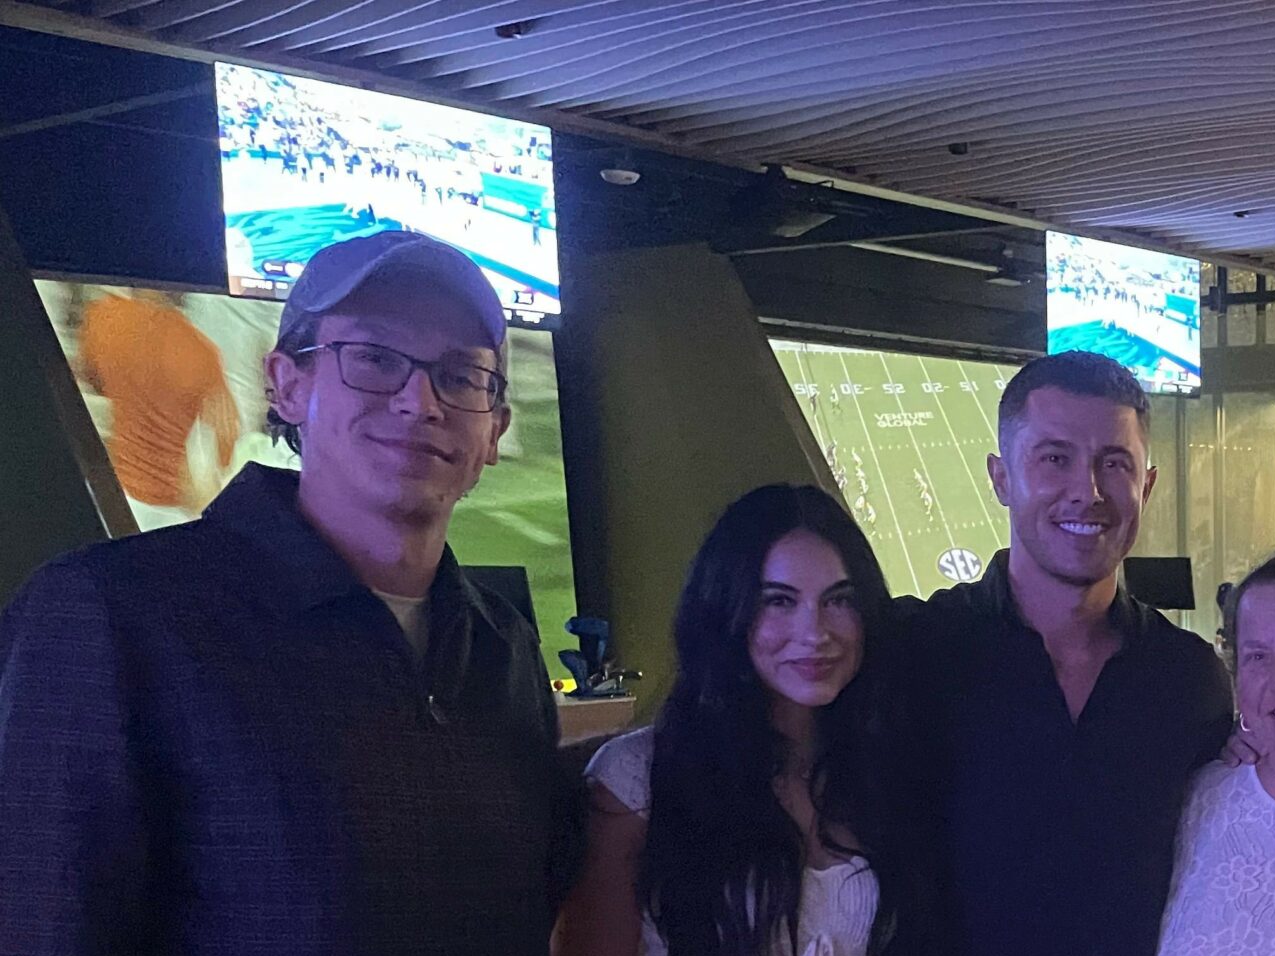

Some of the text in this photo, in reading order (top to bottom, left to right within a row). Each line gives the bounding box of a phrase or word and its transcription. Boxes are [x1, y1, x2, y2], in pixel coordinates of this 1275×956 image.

[874, 411, 934, 421] VENTURE
[877, 418, 927, 428] GLOBAL
[939, 548, 980, 581] SEC
